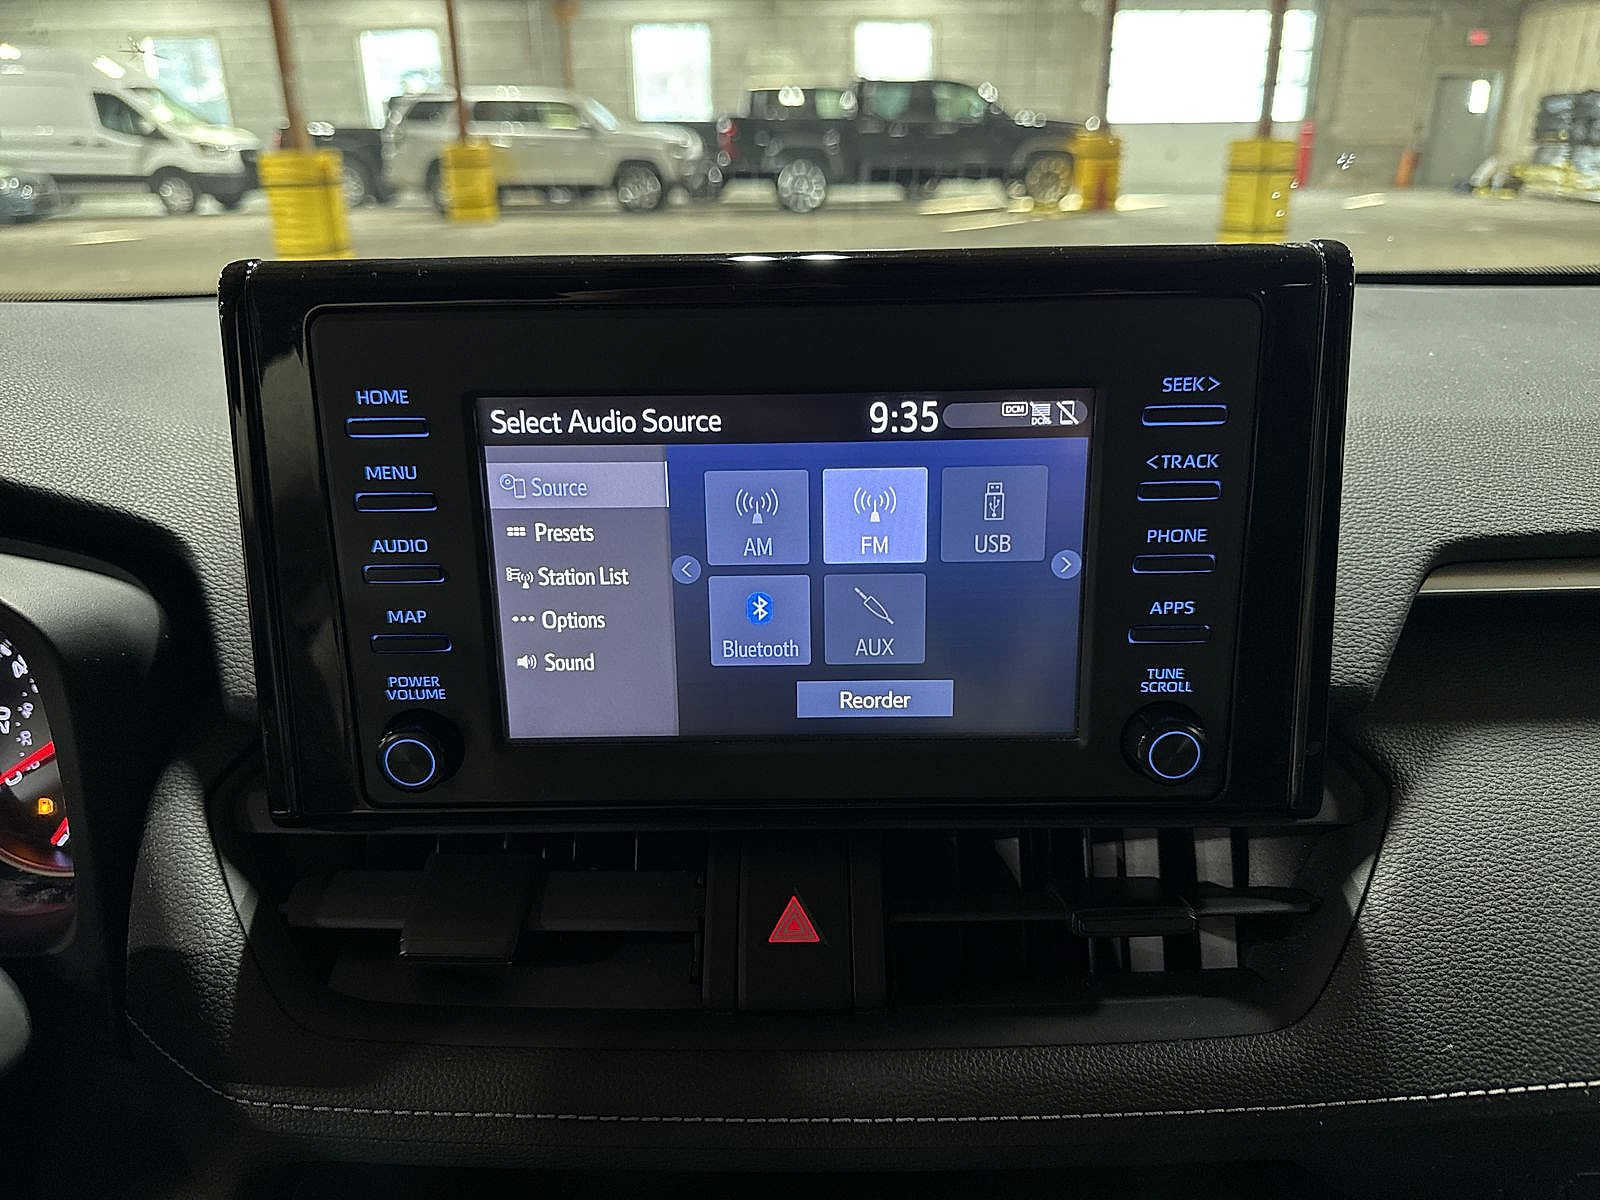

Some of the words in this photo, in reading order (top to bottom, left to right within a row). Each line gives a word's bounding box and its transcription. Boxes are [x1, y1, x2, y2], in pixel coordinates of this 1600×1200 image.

[355, 389, 410, 405] HOME
[869, 400, 939, 434] 9:35
[1005, 405, 1025, 414] DCM
[490, 409, 563, 434] Select
[567, 408, 637, 434] Audio
[641, 408, 722, 433] Source
[365, 465, 417, 481] MENU
[530, 477, 588, 497] Source
[534, 522, 595, 544] Presets
[1146, 528, 1207, 543] PHONE
[372, 538, 428, 553] AUDIO
[743, 537, 773, 557] AM
[860, 535, 889, 556] FM
[974, 534, 1011, 554] USB
[537, 566, 596, 587] Station
[599, 566, 630, 586] List
[1149, 600, 1195, 615] APPS
[386, 610, 427, 624] MAP
[541, 610, 606, 633] Options
[722, 639, 799, 659] Bluetooth
[855, 638, 895, 656] AUX
[544, 652, 595, 672] Sound
[388, 676, 441, 688] POWER
[1147, 668, 1185, 680] TUNE
[386, 688, 446, 701] VOLUME
[1140, 681, 1192, 693] SCROLL
[839, 690, 912, 709] Reorder
